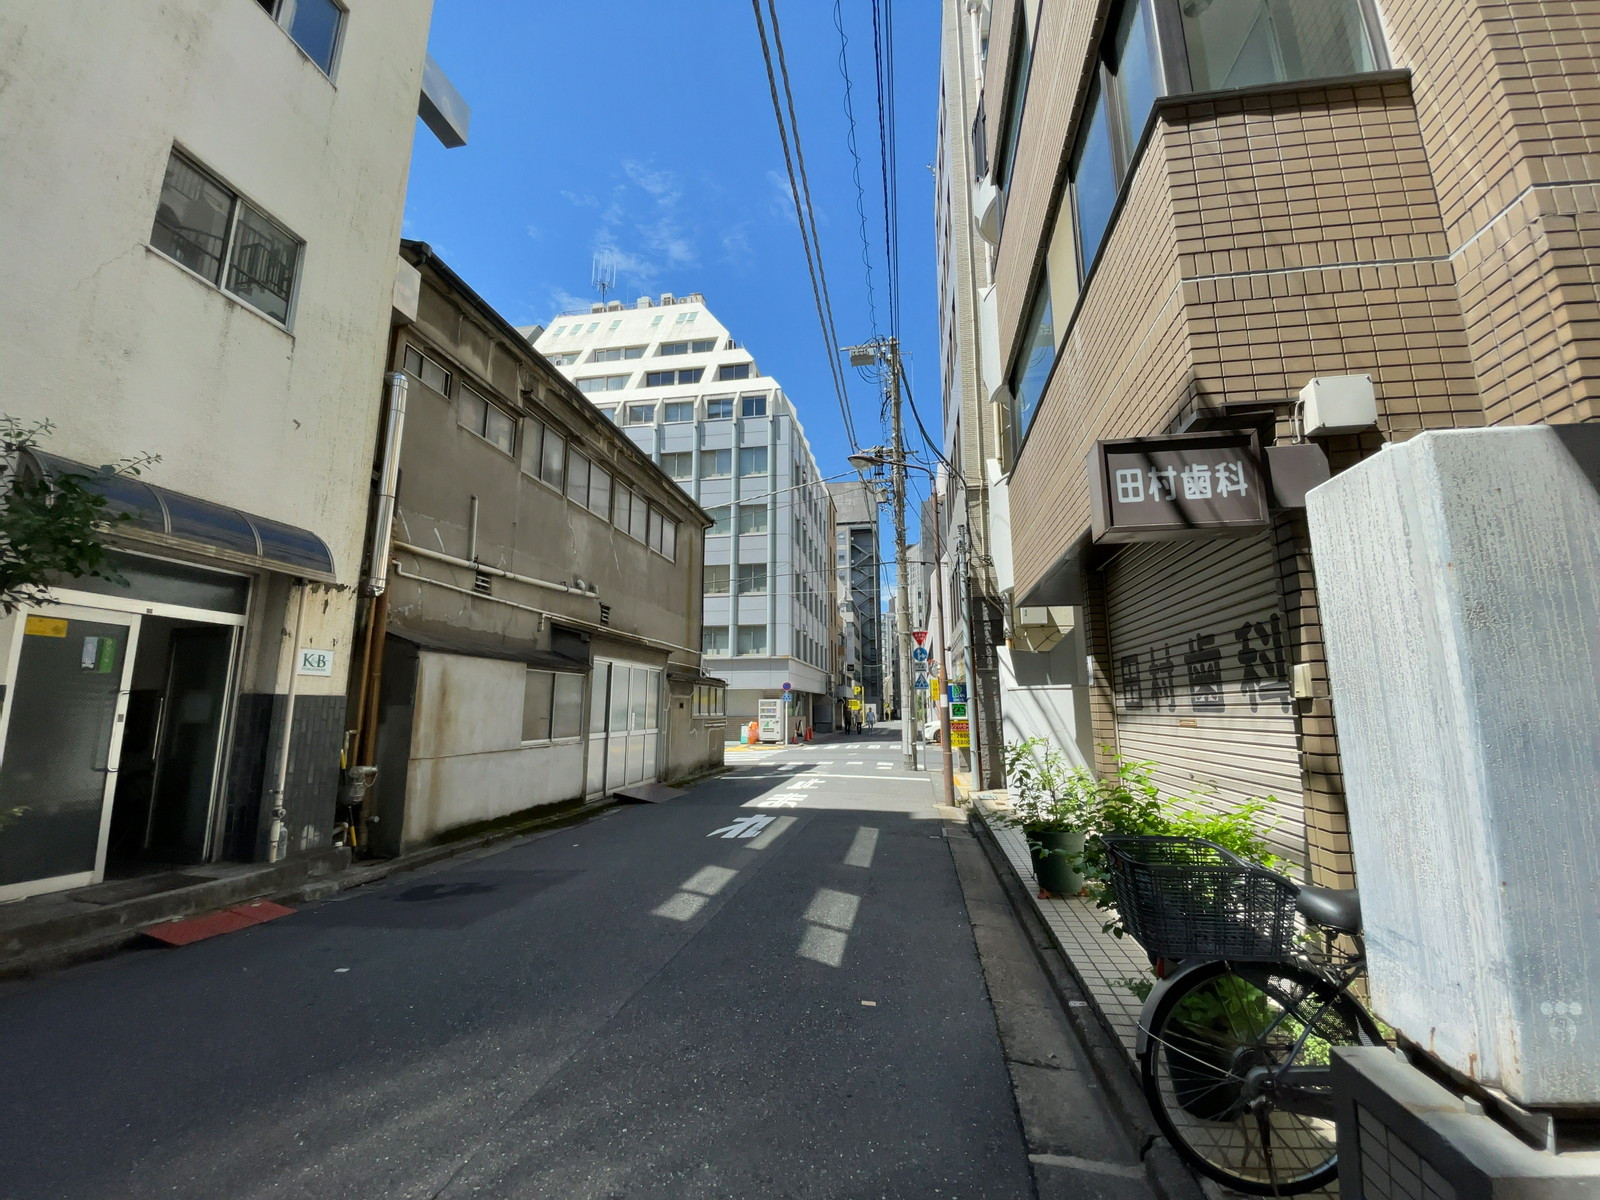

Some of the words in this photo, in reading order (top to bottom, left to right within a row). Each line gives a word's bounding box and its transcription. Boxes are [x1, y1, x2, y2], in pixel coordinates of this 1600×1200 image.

[1115, 460, 1248, 503] 田村歯科
[1120, 612, 1291, 715] 田村歯科
[853, 685, 862, 695] P
[705, 778, 826, 839] 止まれ
